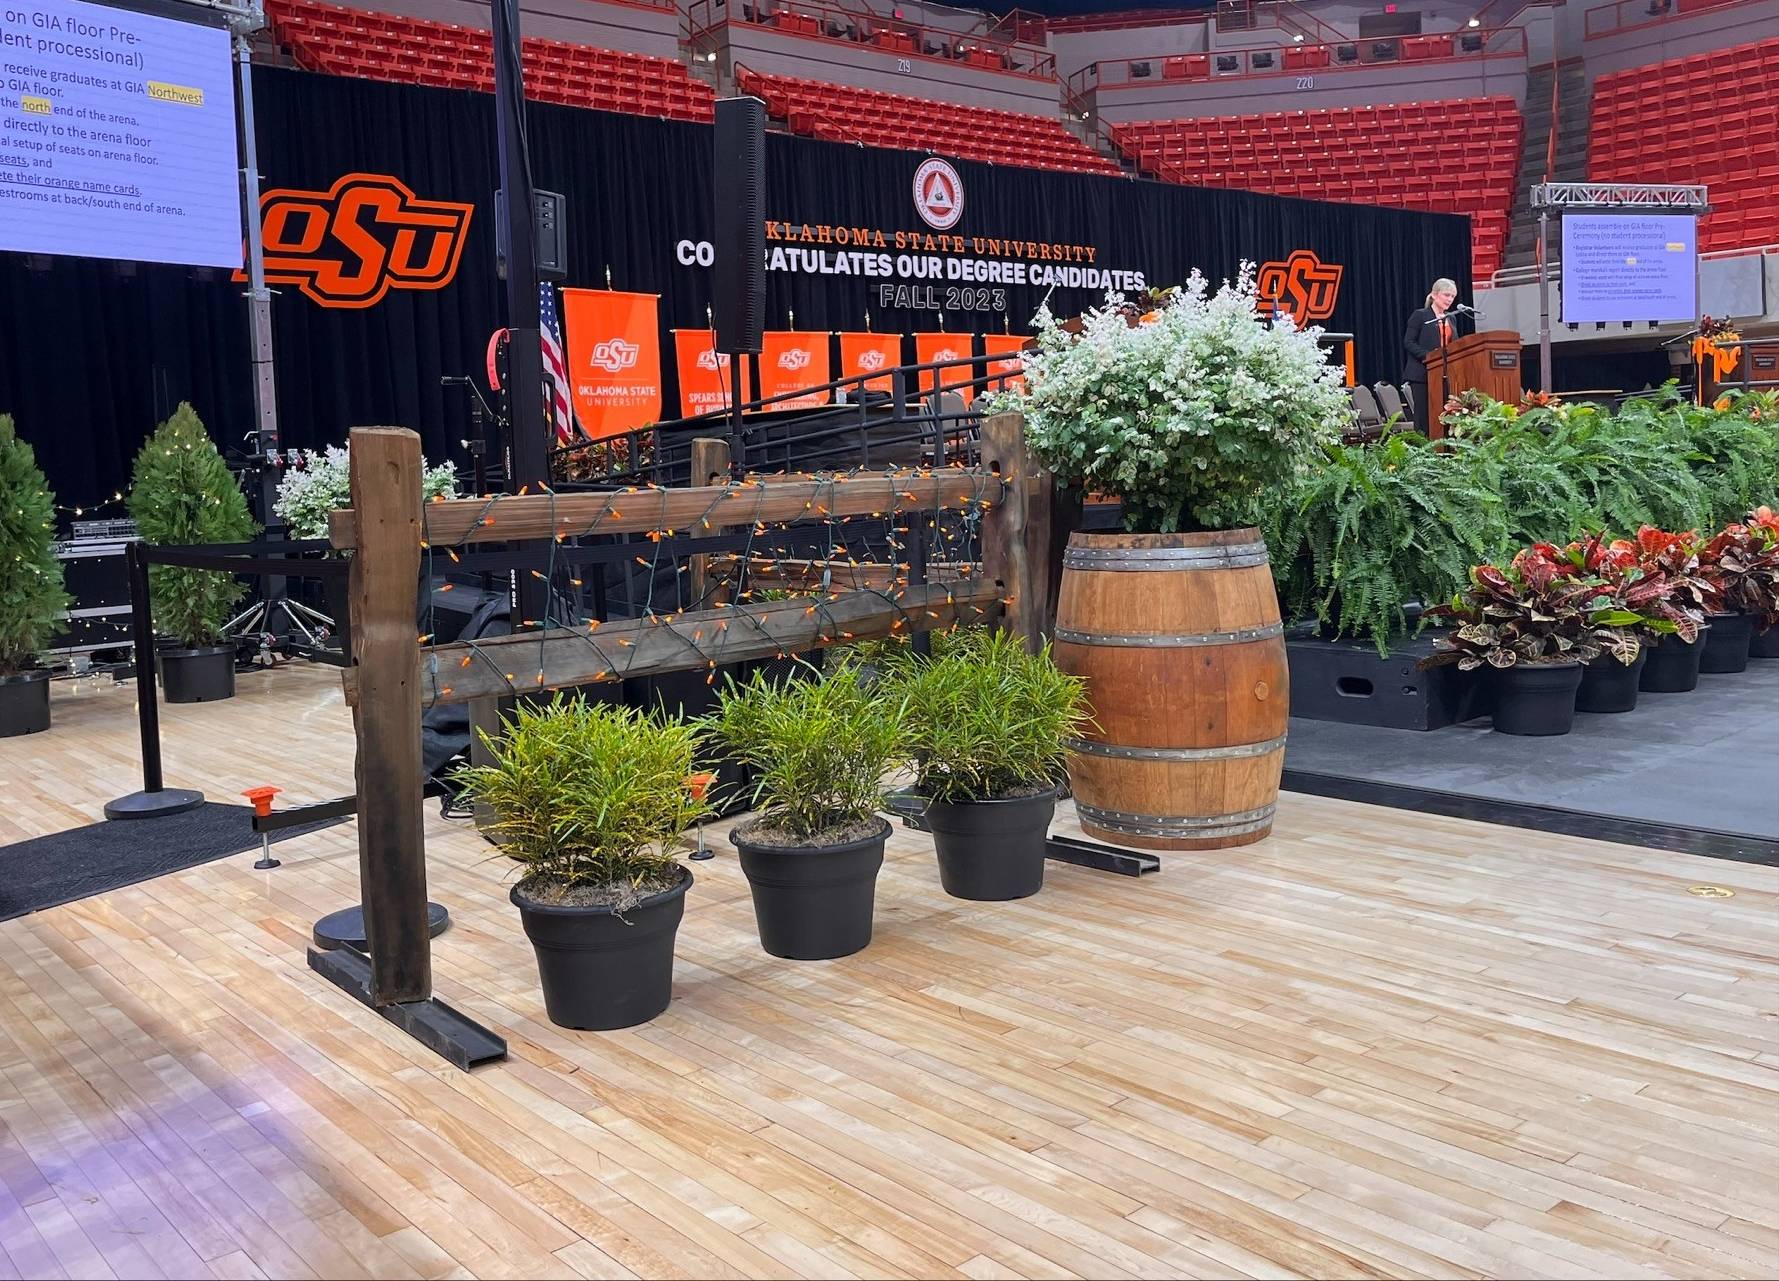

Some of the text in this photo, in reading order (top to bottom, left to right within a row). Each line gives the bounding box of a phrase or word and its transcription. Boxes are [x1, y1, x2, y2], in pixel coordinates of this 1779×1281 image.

[5, 10, 142, 45] on GIA floor Pre-
[38, 39, 144, 71] processional)
[897, 58, 911, 73] 219
[4, 63, 203, 104] receive graduates at GIA Northwest
[8, 78, 31, 92] GIA
[34, 82, 64, 98] floor.
[1296, 76, 1313, 89] 220
[1, 97, 139, 126] the north end of the arena.
[3, 117, 152, 148] directly to the arena floor
[13, 140, 43, 152] setup
[46, 142, 57, 153] of
[59, 145, 86, 157] seats
[88, 148, 101, 158] on
[104, 151, 132, 163] arena
[134, 152, 159, 166] floor.
[33, 158, 53, 168] and
[16, 172, 41, 184] their
[44, 177, 80, 190] orange
[83, 181, 111, 192] name
[113, 184, 142, 196] cards.
[51, 193, 63, 203] at
[65, 193, 121, 210] back/south
[123, 200, 142, 212] end
[144, 203, 154, 214] of
[156, 205, 186, 217] arena.
[231, 172, 475, 309] OSU
[765, 220, 1097, 263] KLAHOMA STATE UNIVERSITY
[896, 254, 943, 280] OUR
[947, 259, 1027, 285] DEGREE
[1029, 264, 1146, 292] CANDIDATES
[879, 284, 1007, 311] FALL 2023
[1256, 249, 1343, 331] OSU
[590, 338, 639, 373] OSU
[778, 348, 811, 371] OSU
[857, 349, 886, 371] OSU
[578, 385, 656, 397] OKLAHOMA STATE
[586, 397, 648, 407] UNIVERSITY
[688, 392, 716, 403] SPEARS
